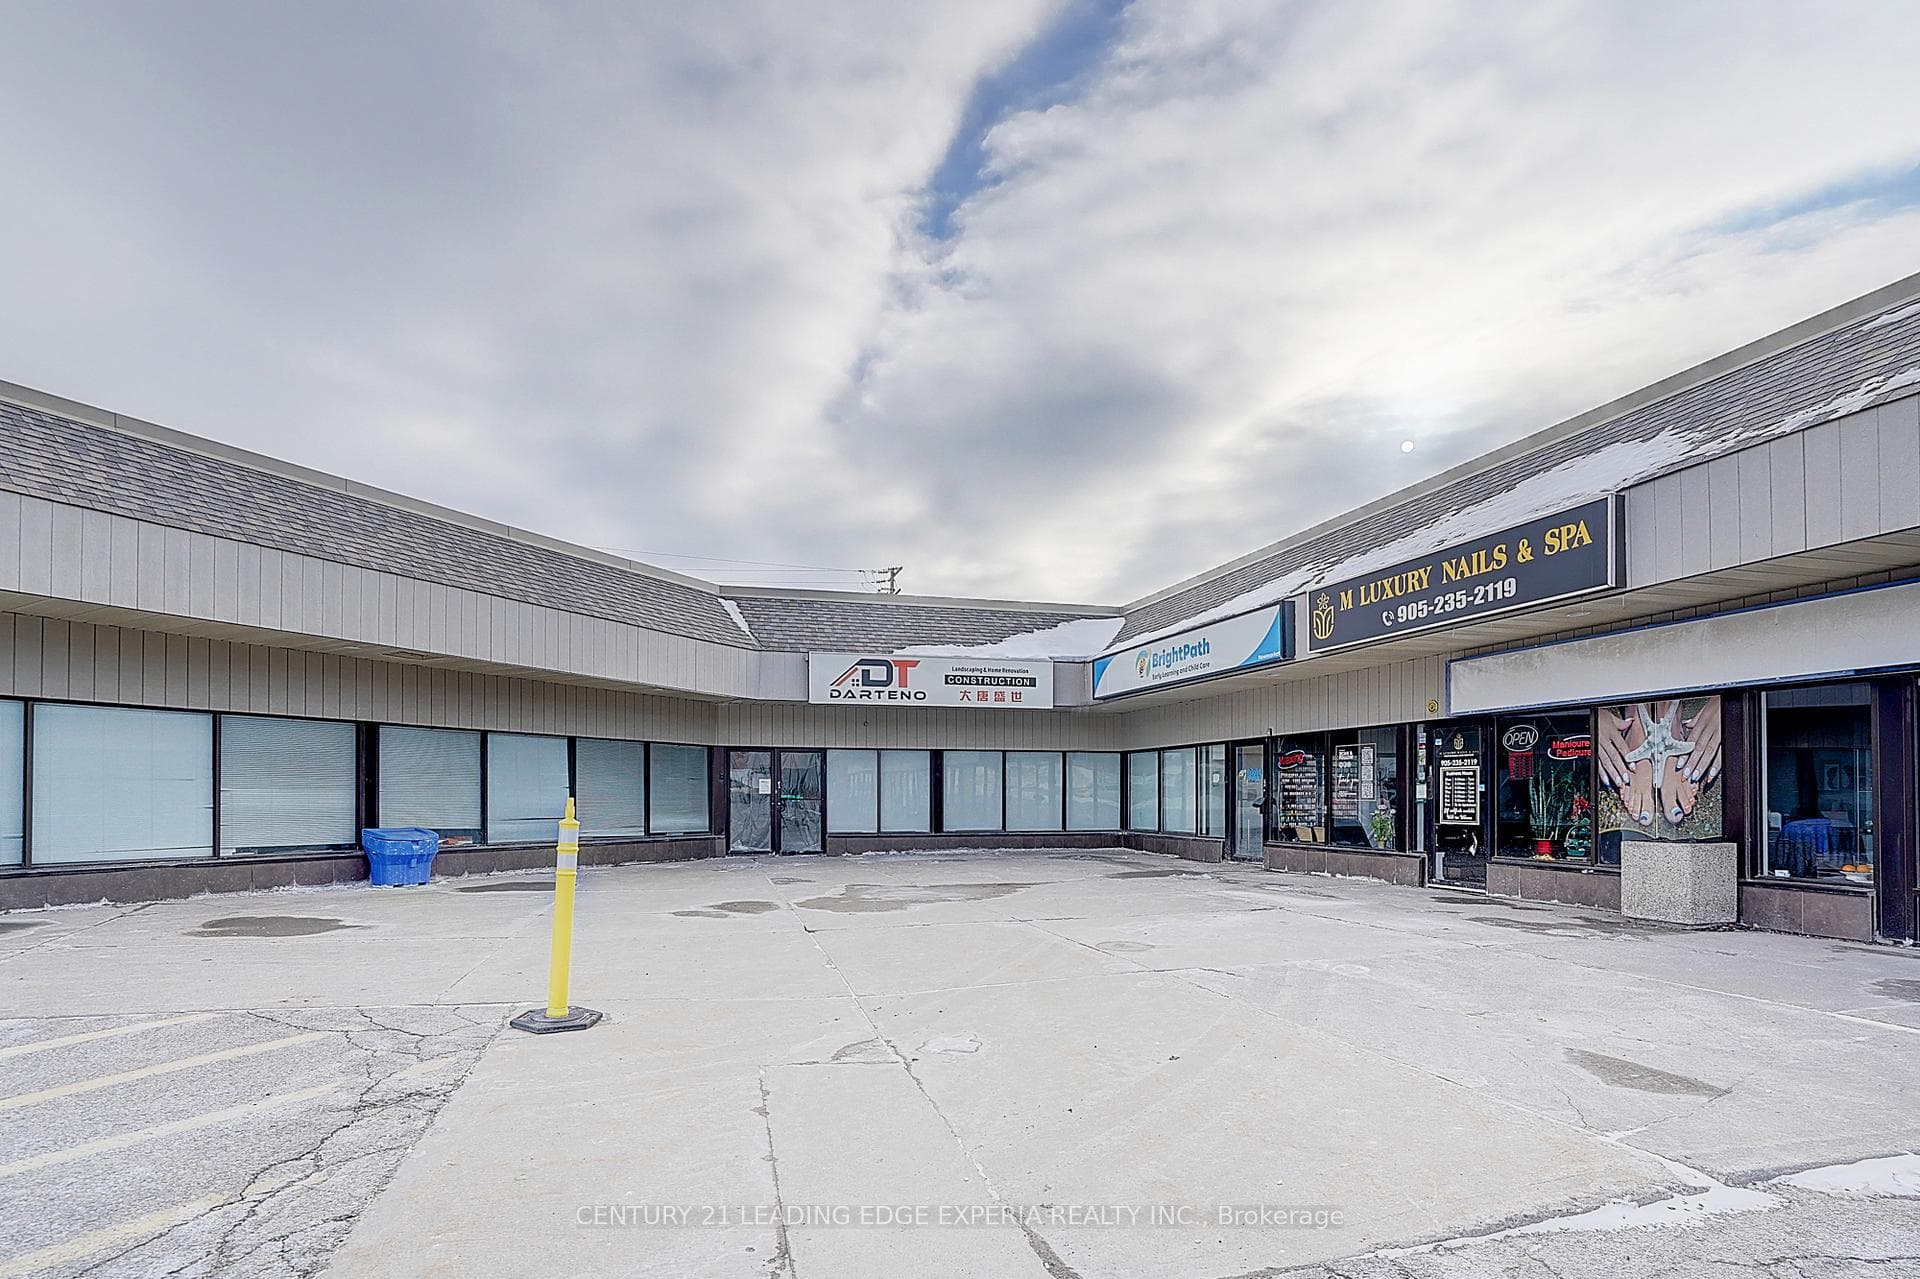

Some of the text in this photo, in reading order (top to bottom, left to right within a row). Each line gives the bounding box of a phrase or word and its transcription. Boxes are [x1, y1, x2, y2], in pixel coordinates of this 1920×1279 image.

[1340, 519, 1593, 611] M LUXURY NAILS & SPA
[1397, 577, 1518, 623] 905-235-2119
[1152, 638, 1210, 668] BrightPath
[1162, 668, 1179, 677] Learning
[1188, 664, 1199, 672] Child
[947, 676, 1030, 686] CONSTRUCTION
[829, 689, 927, 700] DARTENO
[959, 689, 1022, 703] 大唐盛世
[1504, 731, 1535, 746] OPEN
[1552, 740, 1591, 749] Manicure
[1556, 749, 1592, 757] Pedicure
[1440, 758, 1478, 767] 905-235-2119
